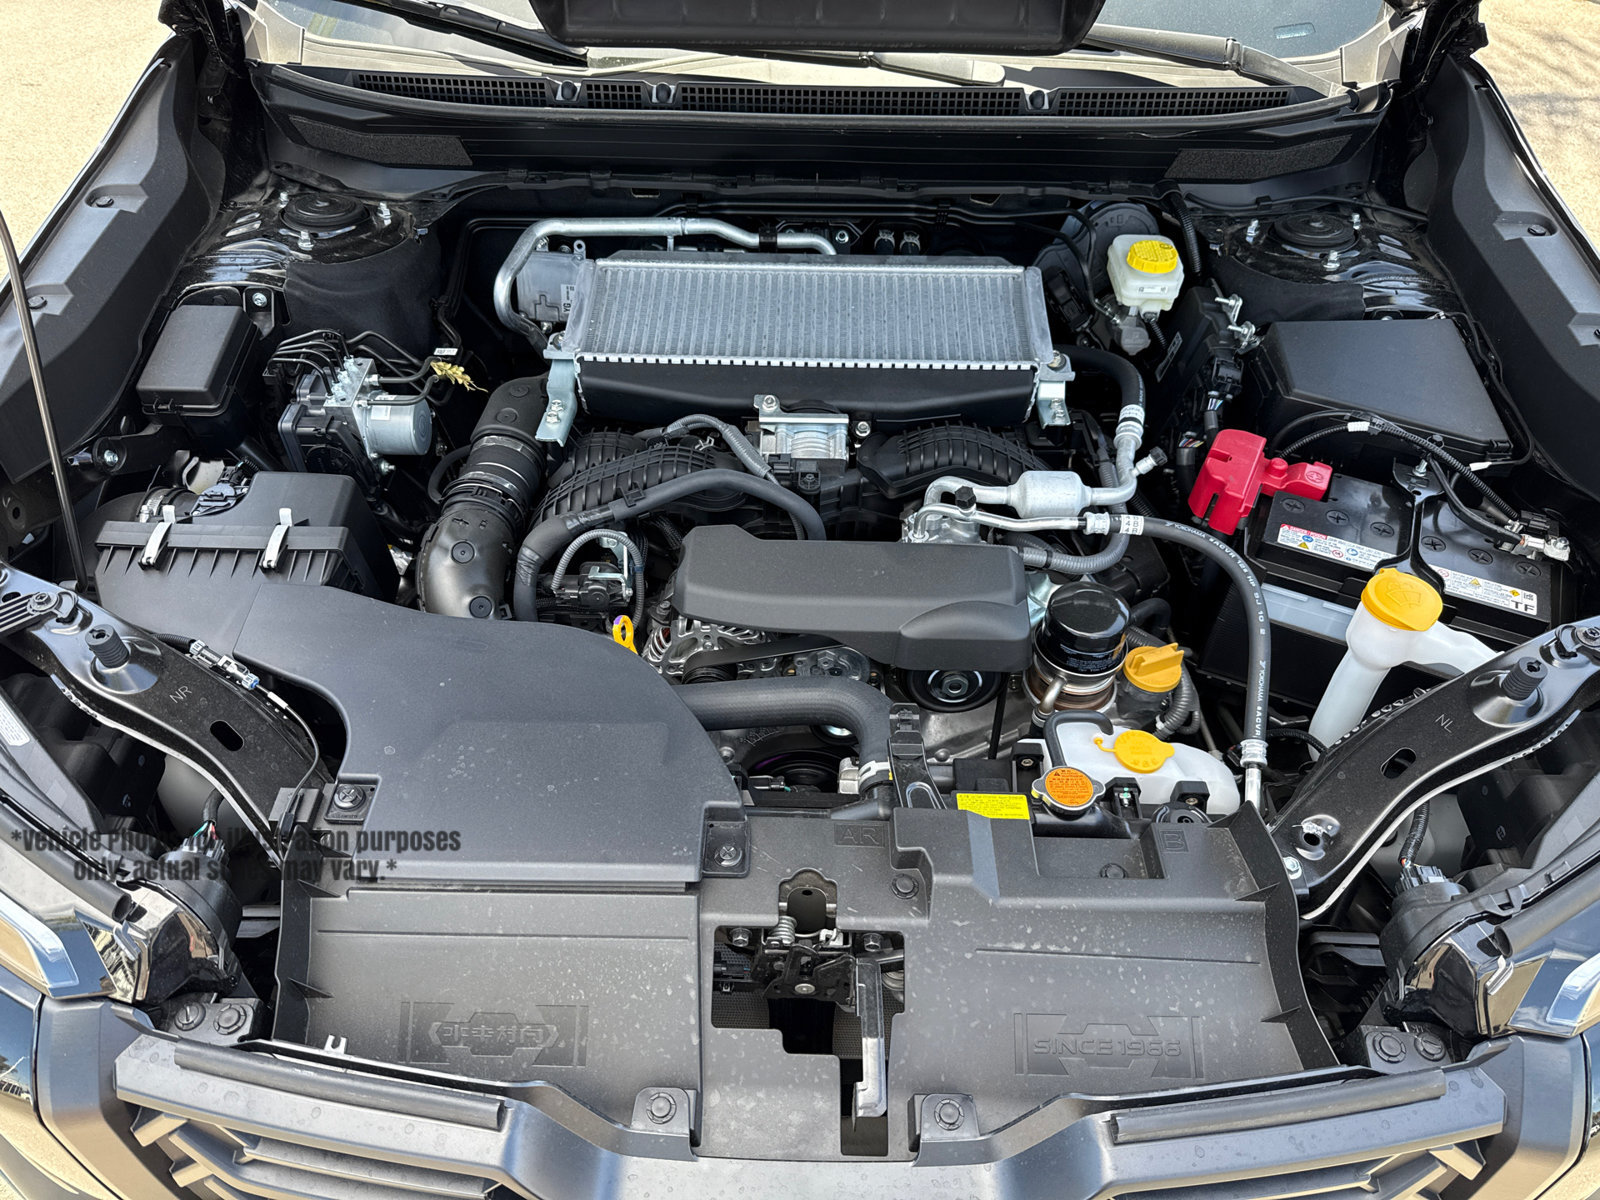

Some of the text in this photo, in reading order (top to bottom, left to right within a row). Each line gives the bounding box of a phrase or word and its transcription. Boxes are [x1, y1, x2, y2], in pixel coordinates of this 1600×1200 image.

[1174, 524, 1206, 538] YOKOHAMA
[1247, 575, 1256, 587] HP
[1258, 610, 1265, 622] 10
[1511, 600, 1535, 612] TF
[169, 685, 192, 703] NR
[1257, 670, 1265, 702] YOKOHAMA
[1435, 713, 1453, 733] NL
[841, 826, 879, 845] AR
[1163, 833, 1185, 850] B
[1034, 1038, 1182, 1057] SINCE 1966
